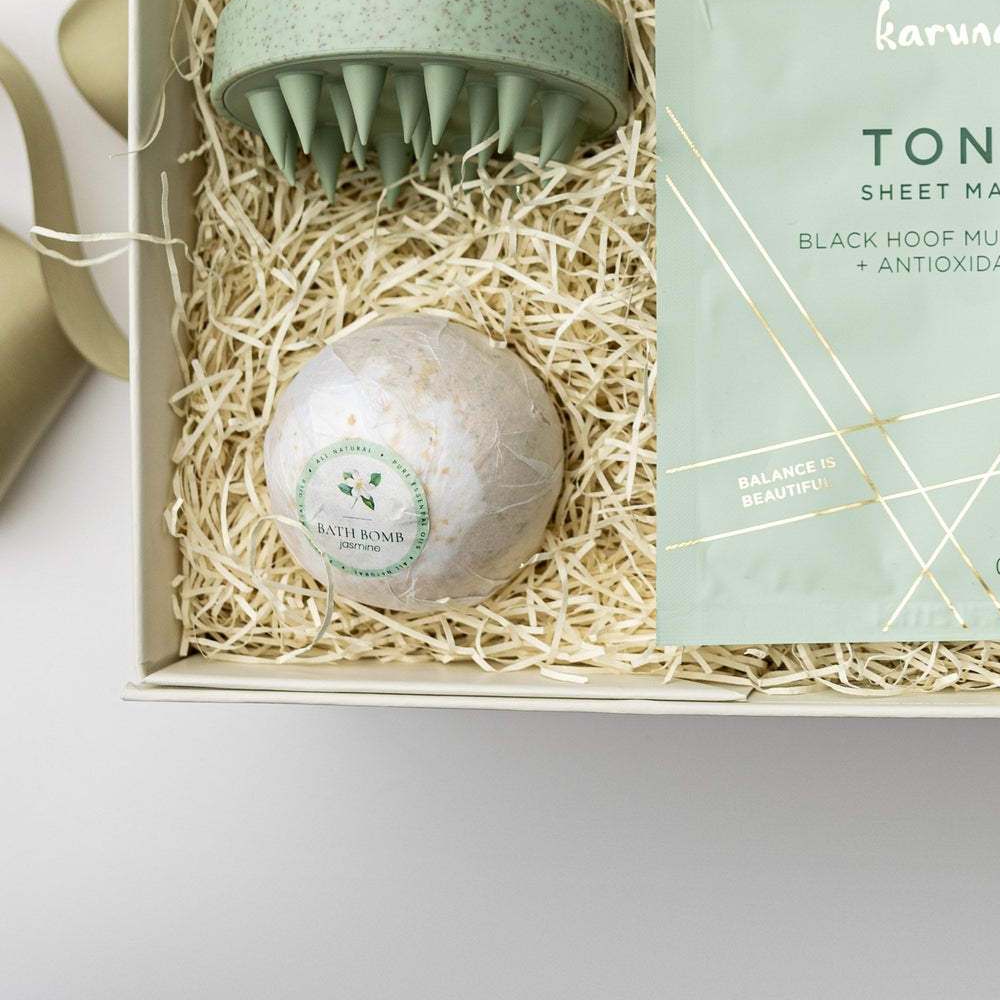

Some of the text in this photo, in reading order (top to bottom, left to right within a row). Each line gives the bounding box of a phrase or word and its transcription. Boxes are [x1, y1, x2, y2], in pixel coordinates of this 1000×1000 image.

[861, 182, 950, 201] SHEET
[799, 231, 878, 250] BLACK
[887, 230, 955, 248] HOOF
[856, 260, 868, 272] +
[333, 445, 372, 455] NATURAL
[738, 456, 836, 490] BALANCE IS
[391, 459, 411, 479] PURE
[410, 481, 429, 527] ESSENTAL
[741, 477, 833, 508] BEAUTIFUL
[317, 522, 404, 543] BATH BOMB
[339, 541, 381, 553] jasmine
